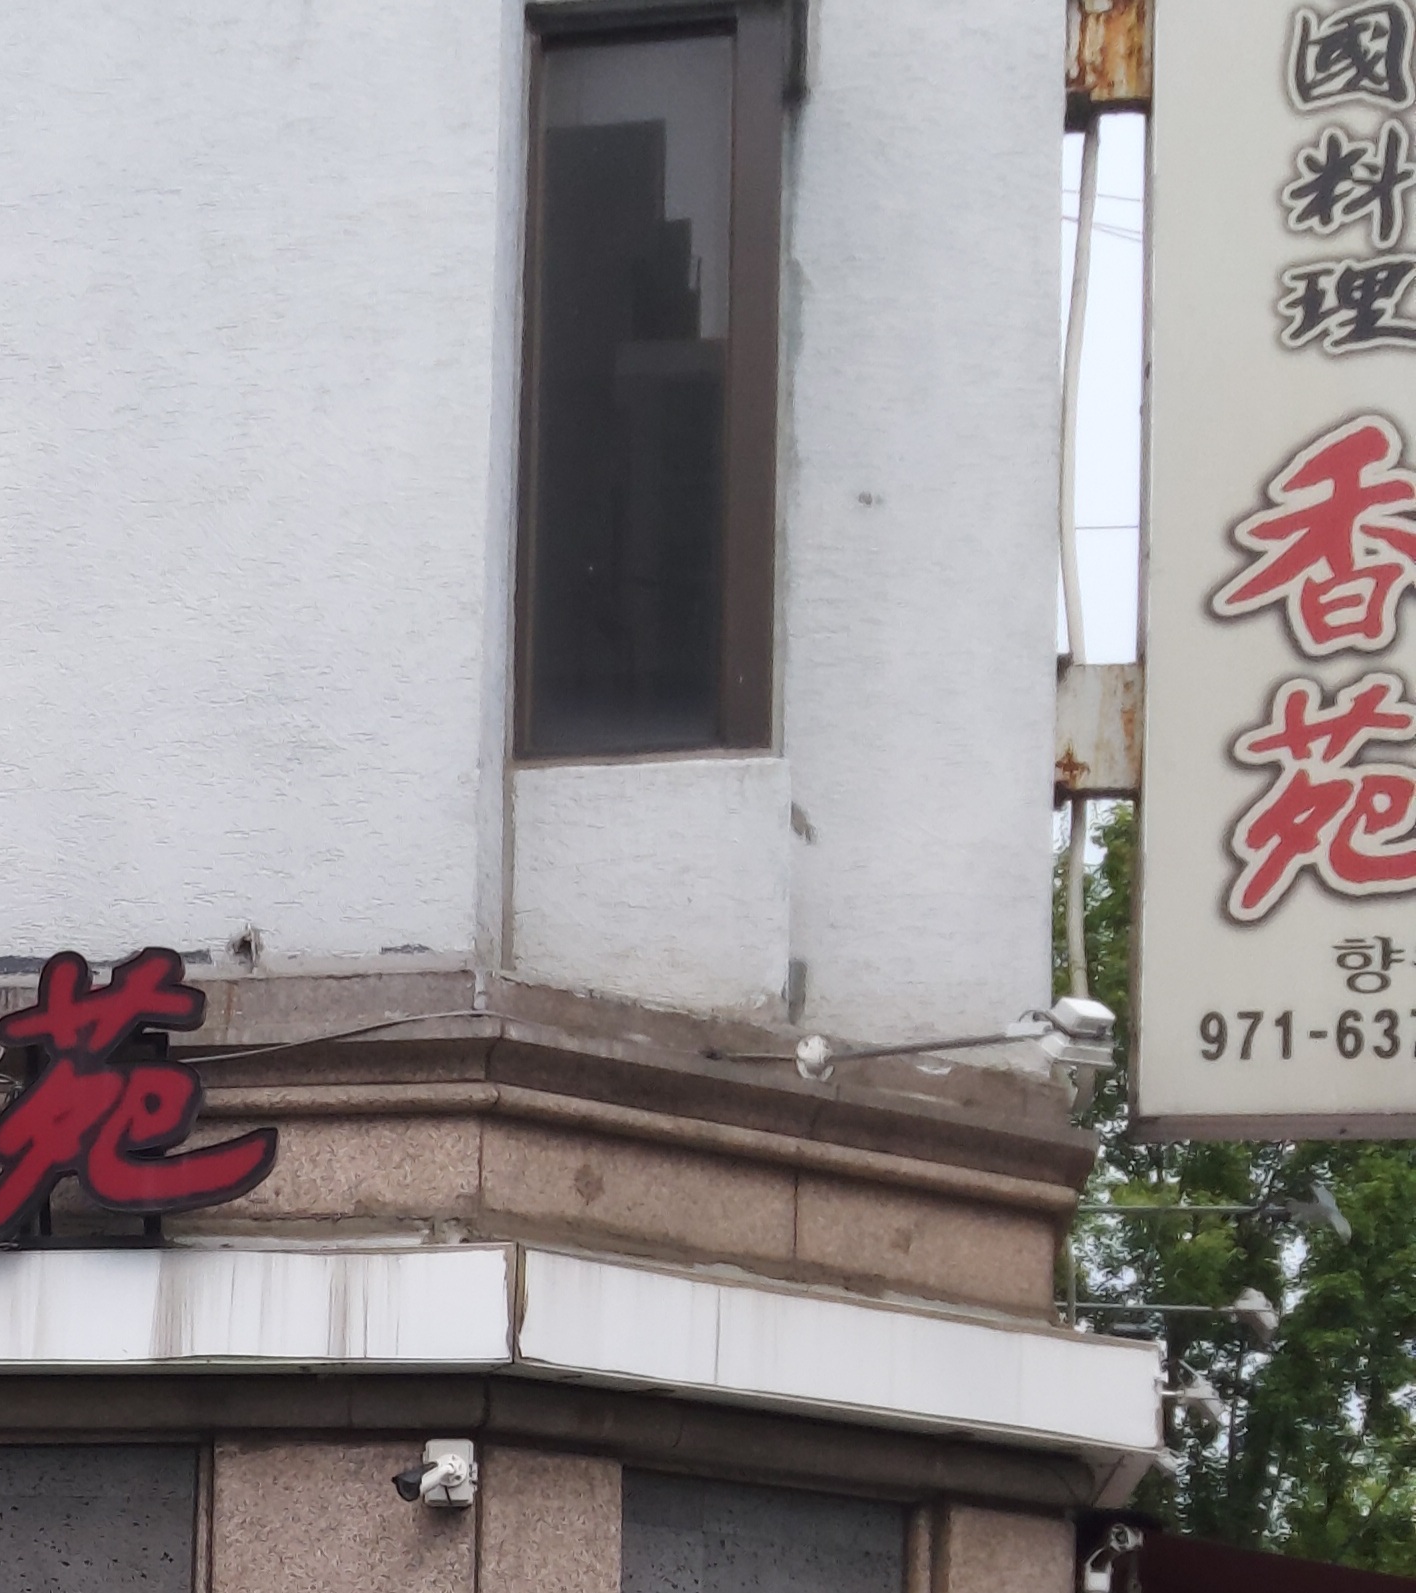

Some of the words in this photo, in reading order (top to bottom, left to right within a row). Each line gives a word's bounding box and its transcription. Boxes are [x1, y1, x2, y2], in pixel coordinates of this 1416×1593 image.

[1221, 424, 1416, 910] 香苑
[1332, 935, 1416, 994] 향
[1199, 1008, 1416, 1061] 971-63
